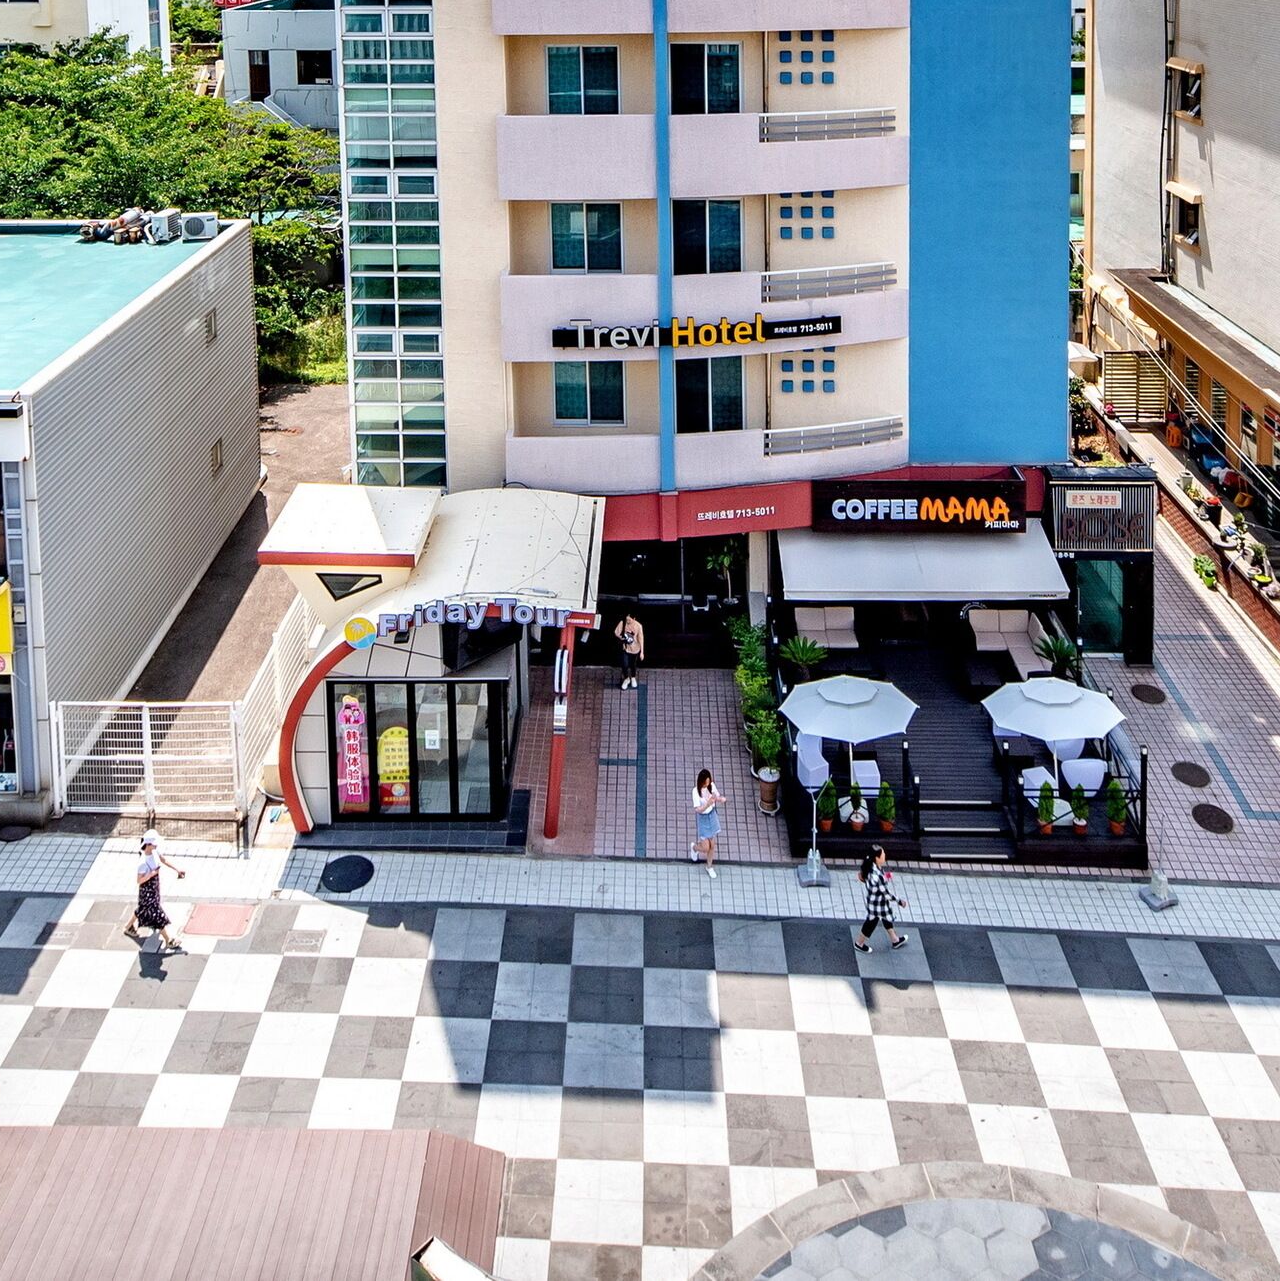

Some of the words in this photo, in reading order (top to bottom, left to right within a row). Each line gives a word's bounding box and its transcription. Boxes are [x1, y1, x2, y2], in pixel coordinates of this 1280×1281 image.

[569, 318, 660, 350] Trevi
[672, 313, 767, 348] Hotel
[800, 322, 833, 333] 713-5011
[697, 509, 734, 521] 뜨레비호텔
[736, 506, 775, 518] 713-5011
[831, 499, 919, 520] COFFEE
[920, 496, 1010, 524] MAMA
[378, 599, 489, 637] Friday
[494, 598, 571, 628] Tour
